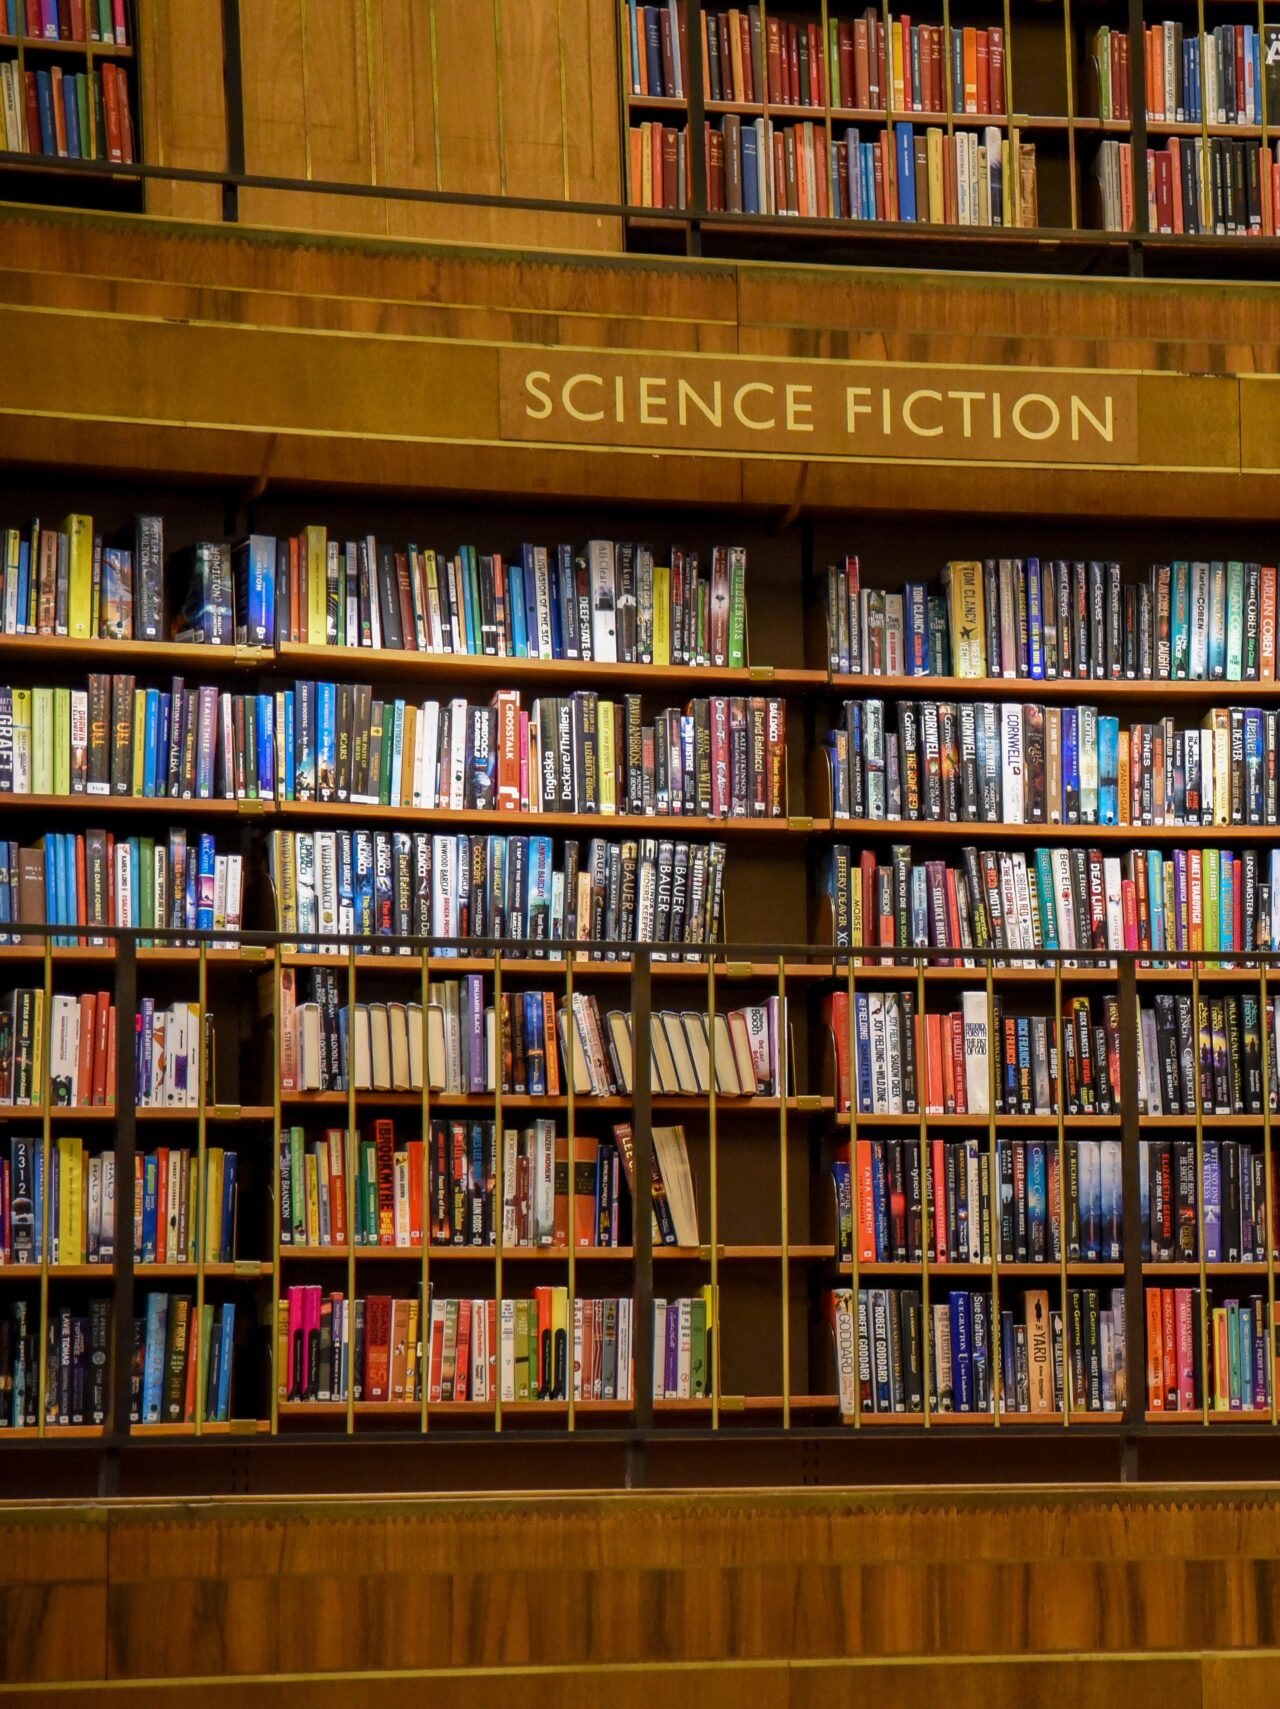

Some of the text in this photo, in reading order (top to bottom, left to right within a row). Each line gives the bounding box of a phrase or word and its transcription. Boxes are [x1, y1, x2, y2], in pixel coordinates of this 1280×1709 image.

[524, 370, 1114, 442] SCIENCE FICTION
[600, 560, 609, 585] Clear
[965, 567, 976, 624] TOM CLANCY
[540, 599, 548, 609] OF
[541, 611, 549, 627] THE
[580, 596, 590, 649] DEEP STATE
[913, 586, 924, 633] TOM CLANCY
[1060, 583, 1069, 617] Cleeves
[1248, 599, 1258, 637] COBEN
[1263, 571, 1273, 656] HARLAN COBEN
[1159, 641, 1169, 670] CAUGHT
[203, 697, 212, 724] BRAIN
[506, 704, 515, 759] CROSSTALK
[630, 698, 642, 766] DAVID AMBROSE
[770, 703, 778, 741] BALDACCI
[905, 712, 915, 750] Cornwell
[0, 715, 13, 769] GRAFT
[170, 744, 180, 772] ALBA
[340, 732, 348, 760] SCARS
[561, 706, 572, 800] Deckare/Thrillers
[755, 711, 764, 772] David Baldacci
[962, 711, 975, 760] CORNWELL
[1008, 714, 1018, 766] CORNWELL
[1232, 728, 1242, 761] DEAVER
[544, 751, 556, 800] Engelska
[698, 773, 710, 801] WILL
[473, 846, 482, 884] GOODBYE
[595, 844, 605, 886] BAUER
[622, 862, 635, 910] BAUER
[1246, 856, 1254, 914] LINDA FARSTEIN
[382, 900, 390, 914] The
[673, 866, 686, 912] BAUER
[837, 856, 847, 926] JEFFERY DEAVER
[989, 889, 1001, 916] MOTH
[1091, 863, 1103, 921] DEAD LINE
[1191, 855, 1201, 923] JANET EVANOVICH
[752, 1008, 760, 1035] Booth
[874, 1018, 885, 1062] JOY FIELDING
[331, 1034, 339, 1074] BLOODLINE
[380, 1128, 392, 1210] BROOKMYRE
[281, 1167, 290, 1218] JAY BRANDON
[472, 1198, 481, 1232] RAIN GODS
[62, 1313, 70, 1365] LAVIE TIDHAR
[875, 1306, 887, 1382] ROBERT GODDARD
[974, 1296, 983, 1347] Sue Grafton
[1034, 1332, 1046, 1362] YARD
